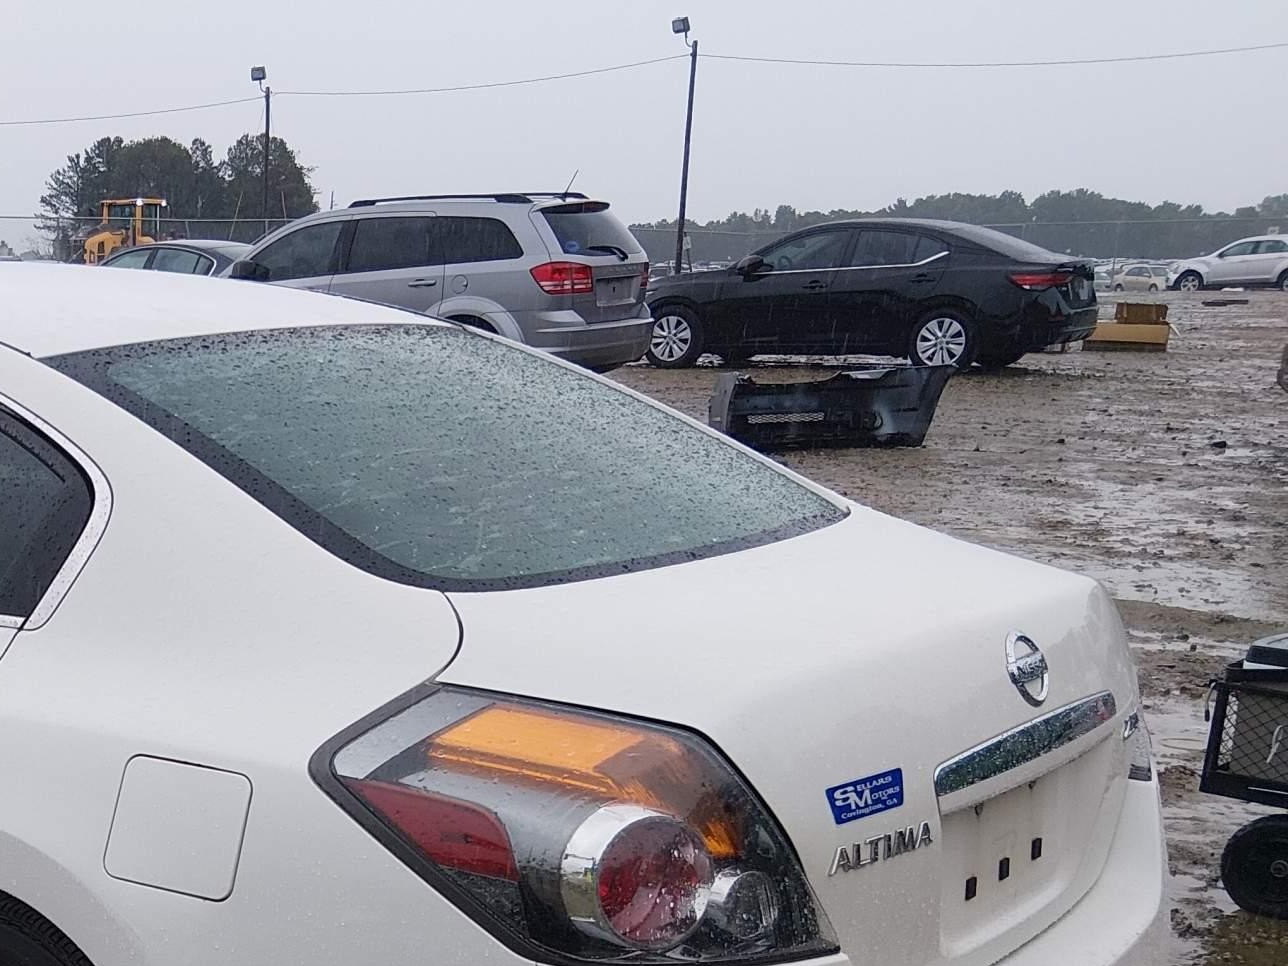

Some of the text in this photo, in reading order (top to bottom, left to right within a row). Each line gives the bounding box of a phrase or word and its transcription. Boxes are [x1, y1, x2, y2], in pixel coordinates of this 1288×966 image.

[833, 776, 892, 806] SELLARS
[849, 785, 900, 810] MOTORS
[827, 821, 933, 877] ALTIMA
